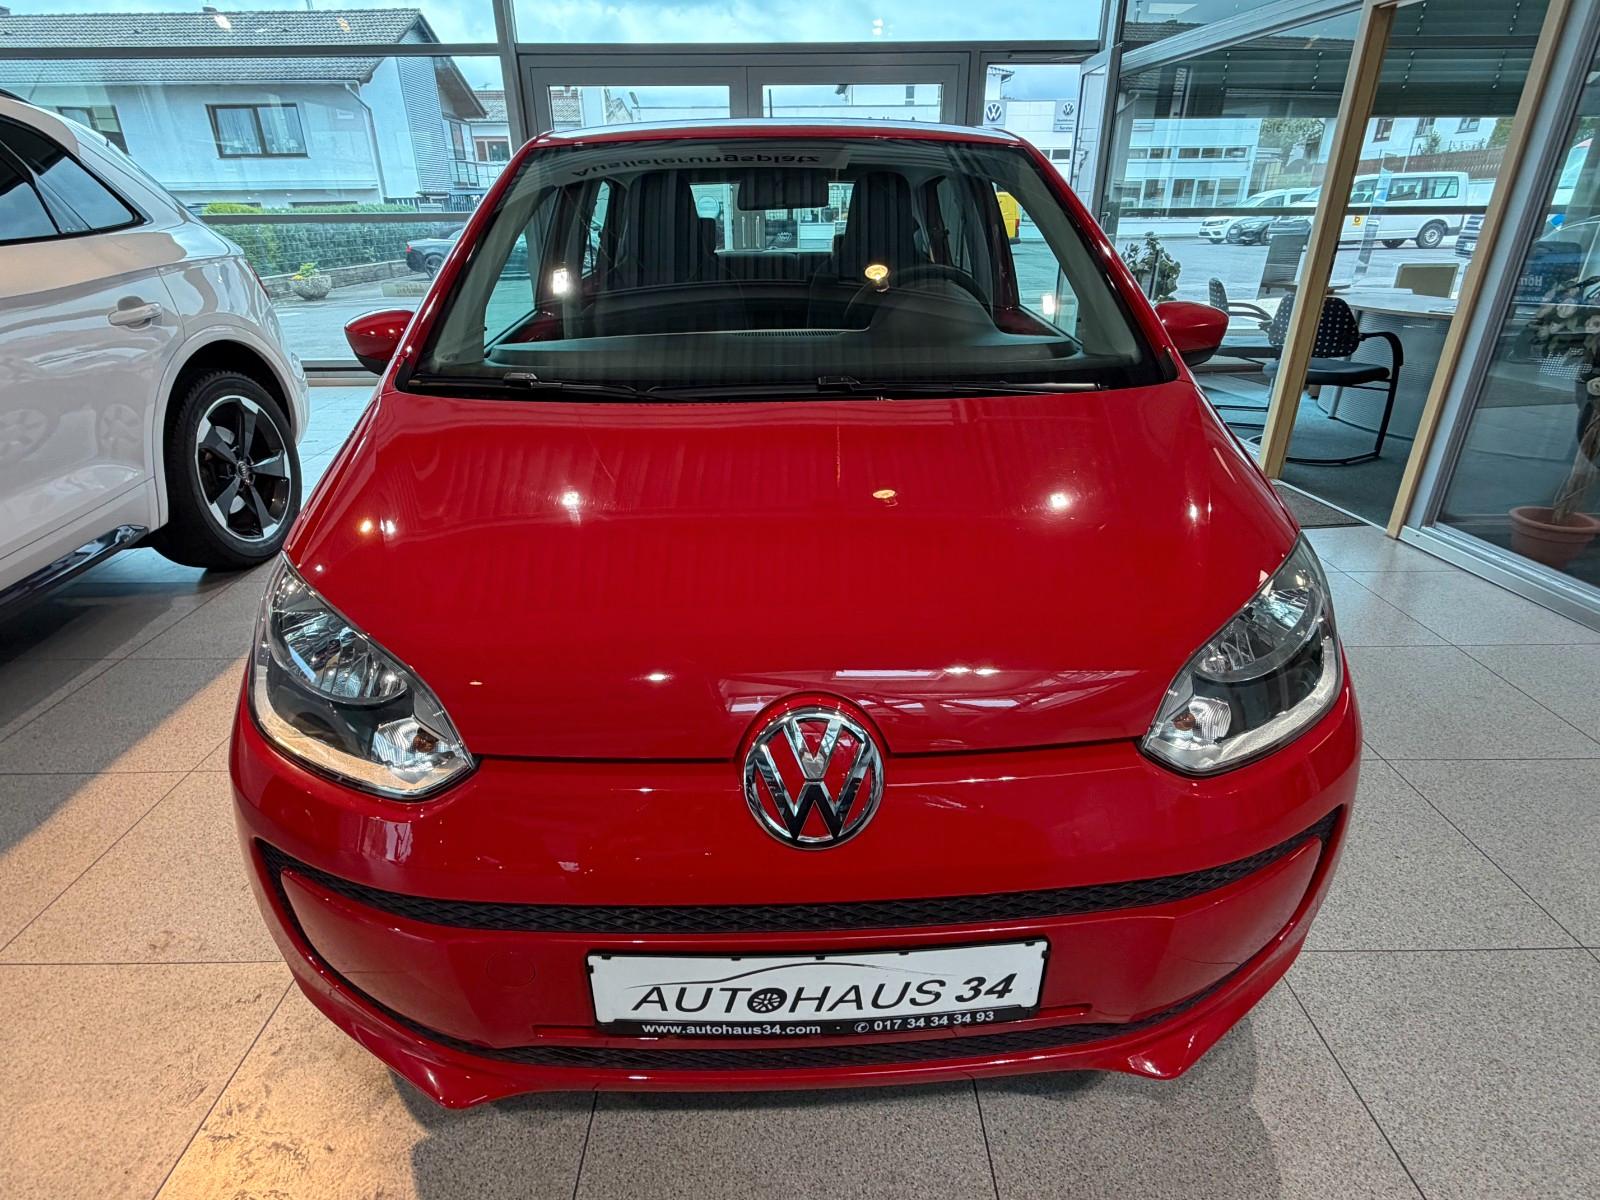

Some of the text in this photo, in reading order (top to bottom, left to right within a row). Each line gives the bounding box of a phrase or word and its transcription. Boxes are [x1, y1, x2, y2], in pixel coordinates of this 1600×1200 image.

[744, 708, 884, 849] VW
[631, 973, 1018, 1014] AUTOHAUS 34
[642, 1023, 822, 1036] www.autohaus34.com
[873, 1010, 995, 1032] 017 34 34 34 93
